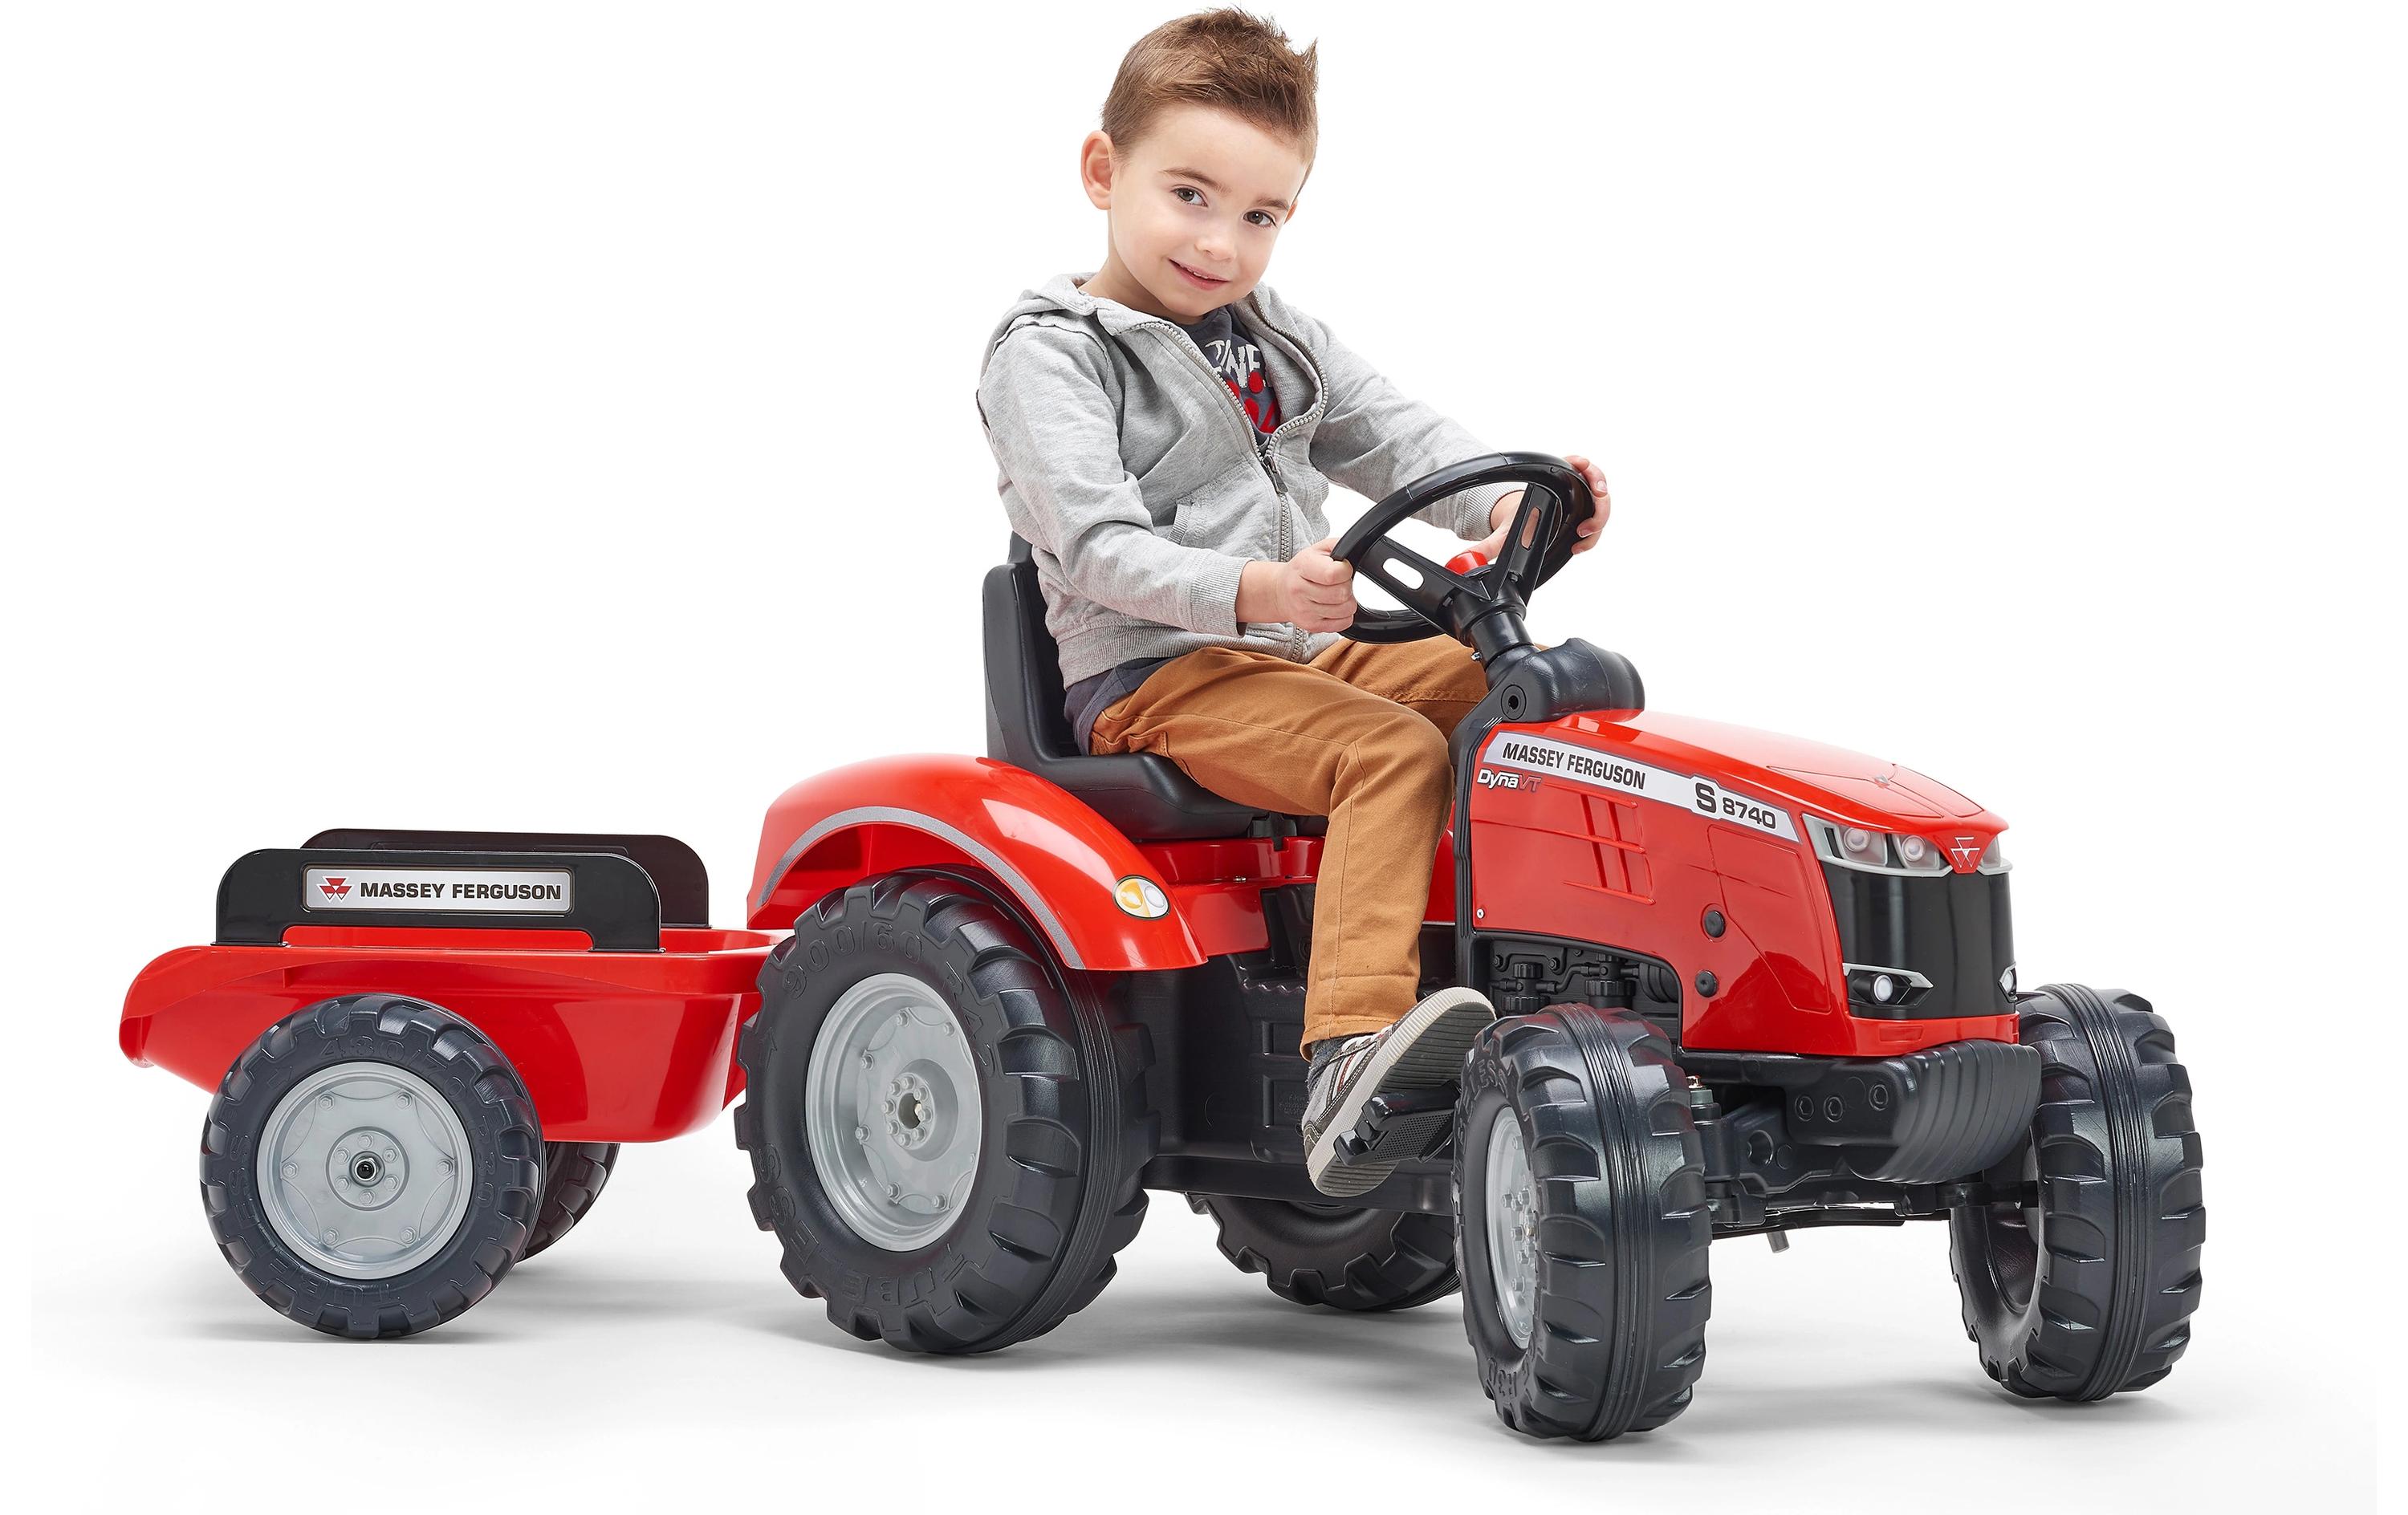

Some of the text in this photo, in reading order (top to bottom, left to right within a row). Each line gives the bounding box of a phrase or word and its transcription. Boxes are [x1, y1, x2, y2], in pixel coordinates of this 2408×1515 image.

[1502, 742, 1646, 790] MASSEY FERGUSON
[1695, 782, 1776, 830] S 8740
[360, 882, 561, 900] MASSEY FERGUSON
[782, 920, 923, 1000] 900/60
